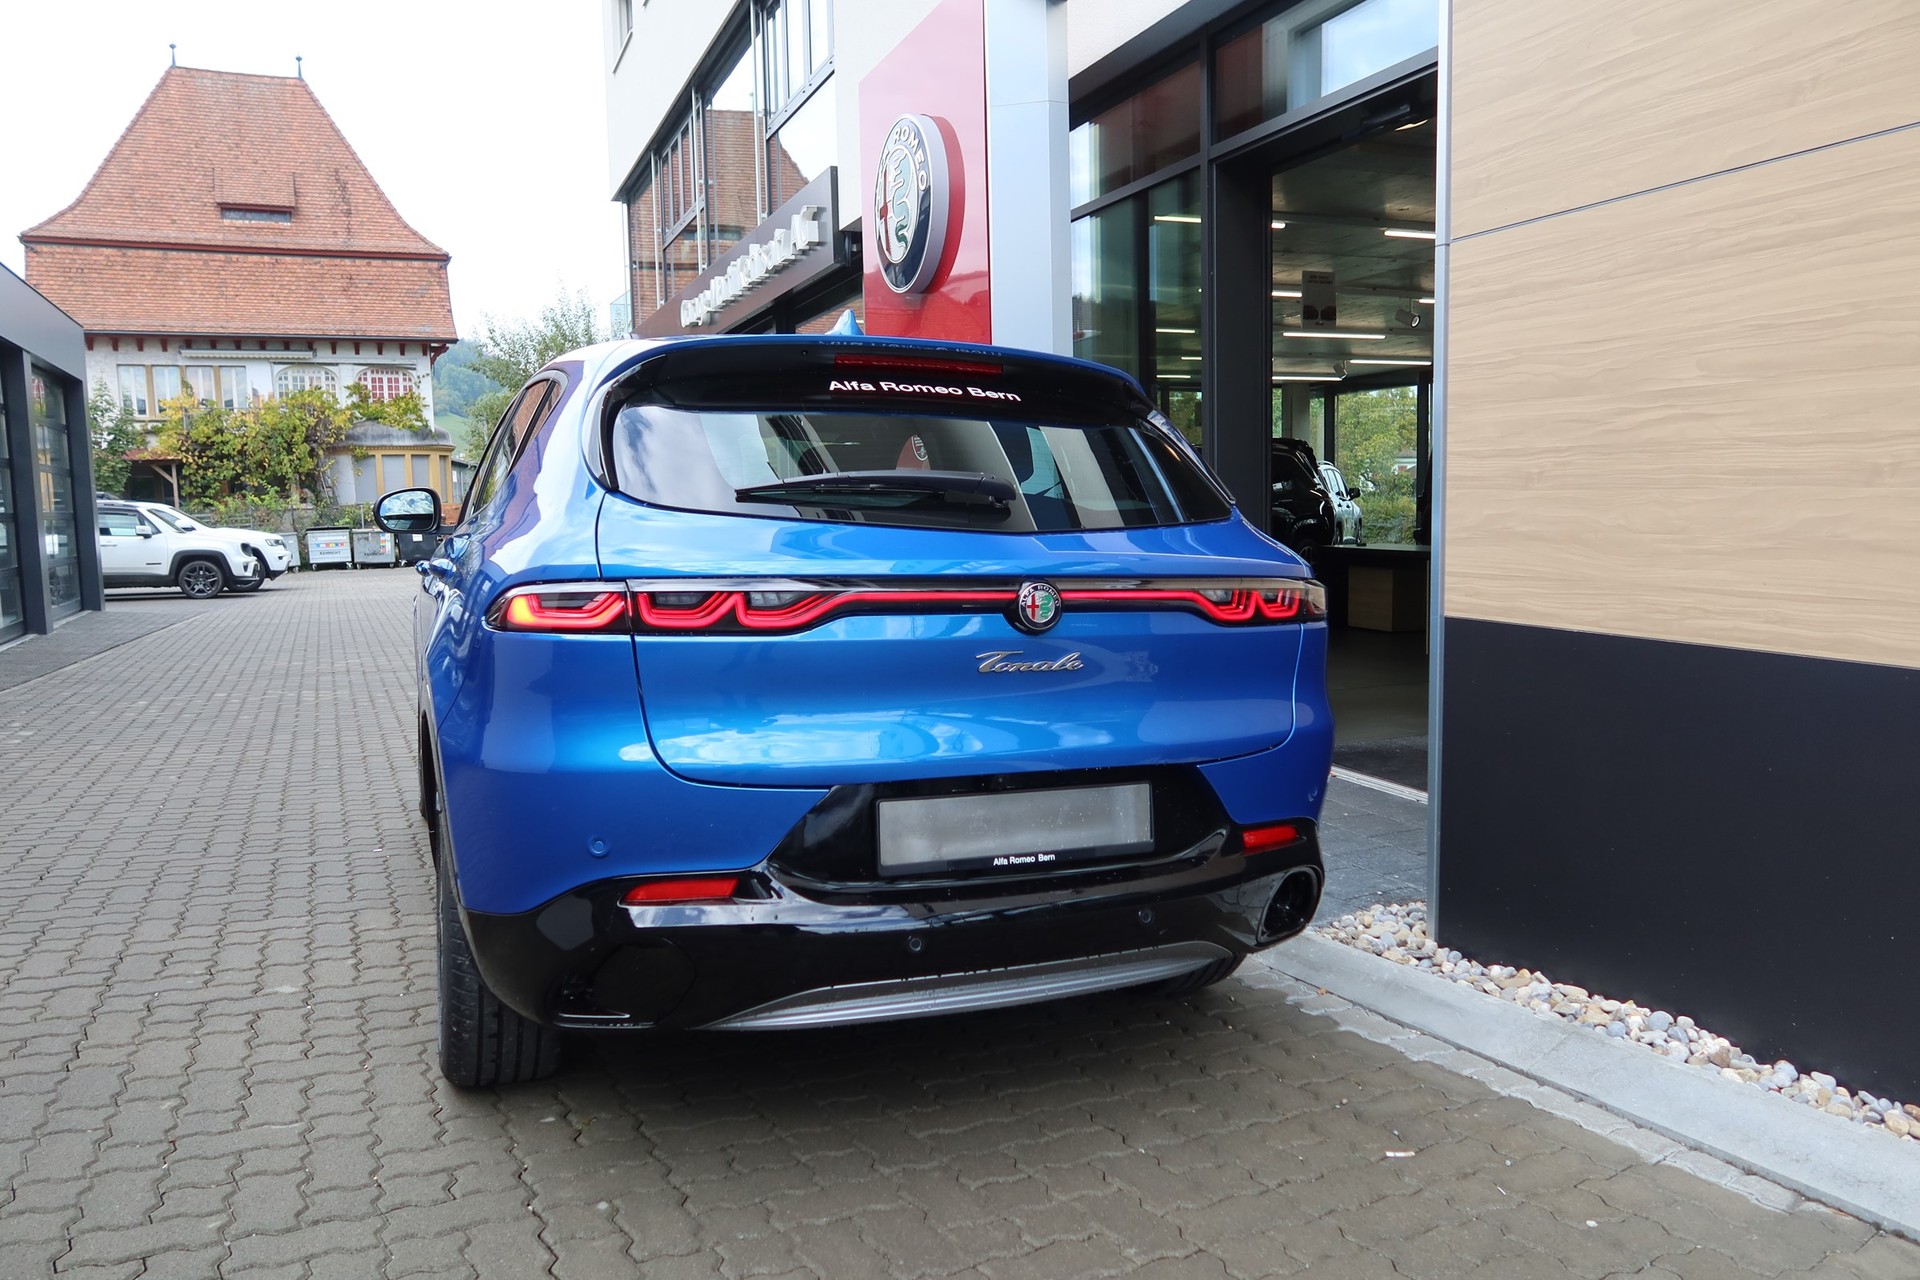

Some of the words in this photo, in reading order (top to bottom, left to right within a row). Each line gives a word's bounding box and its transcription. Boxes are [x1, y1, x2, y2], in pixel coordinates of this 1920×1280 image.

[893, 124, 928, 191] ROMEO
[829, 380, 876, 391] Alfa
[878, 381, 963, 395] Romeo
[966, 387, 1022, 402] Bern
[1021, 587, 1035, 607] ALFA
[1037, 585, 1059, 607] ROMEO
[976, 650, 1084, 673] Tonale
[993, 857, 1008, 866] Alfa
[1009, 856, 1035, 865] Romeo
[1038, 853, 1056, 862] Bern
